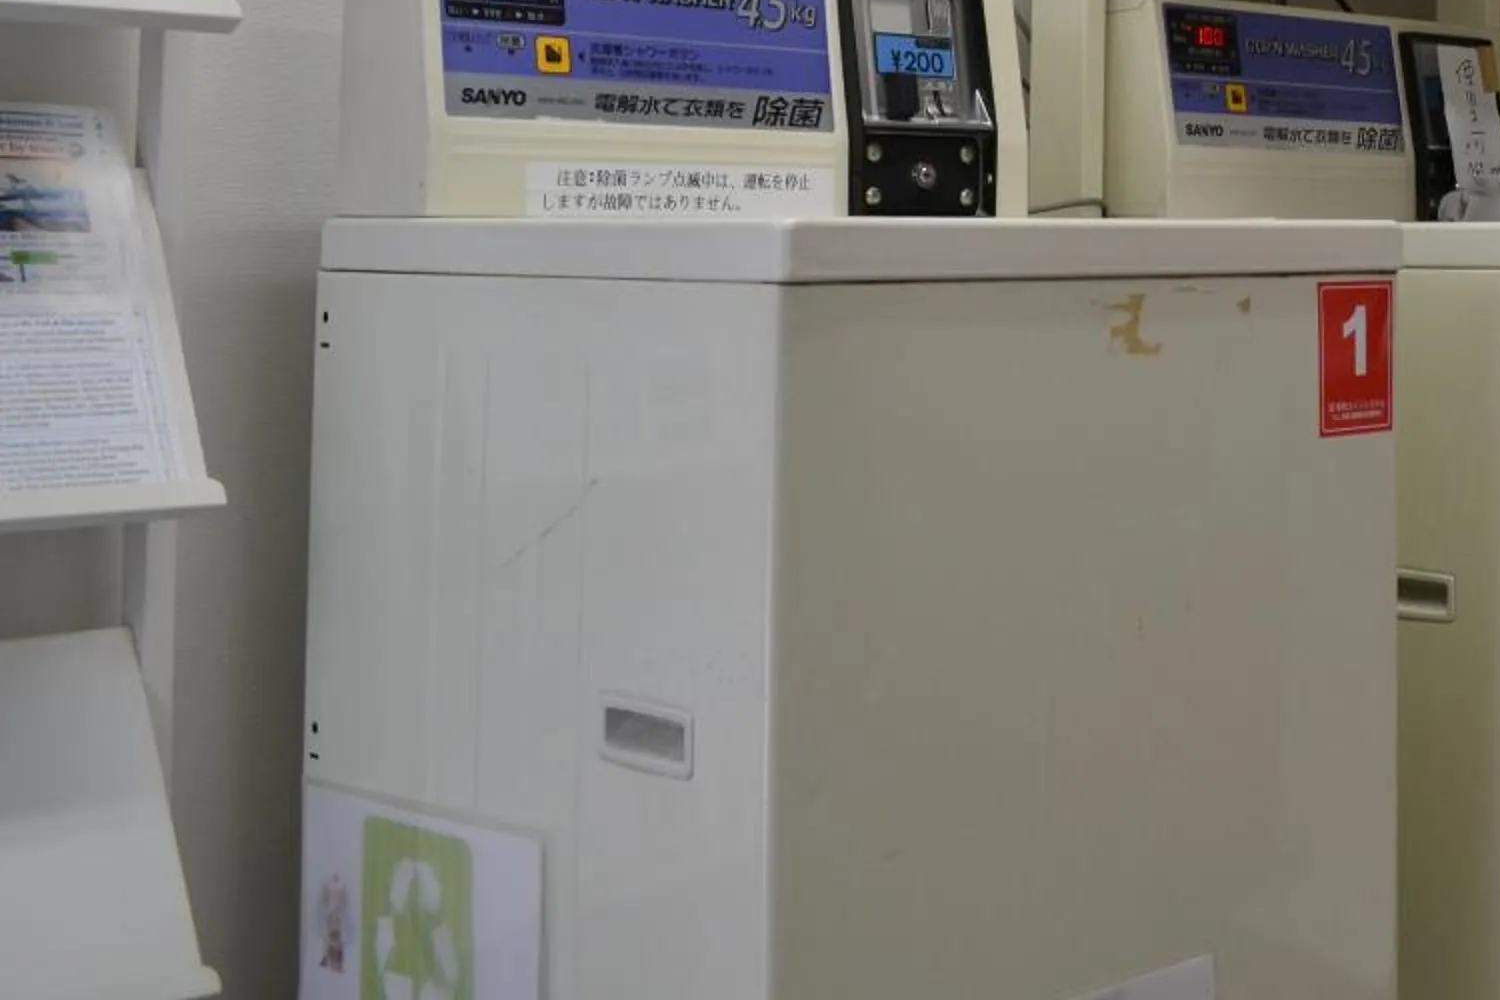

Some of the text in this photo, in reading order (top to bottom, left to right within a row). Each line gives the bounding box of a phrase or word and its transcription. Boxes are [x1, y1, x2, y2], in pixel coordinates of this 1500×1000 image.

[890, 50, 945, 74] ¥200
[460, 87, 527, 108] SANYO
[1184, 122, 1225, 138] SANYO
[1342, 304, 1367, 377] 1
